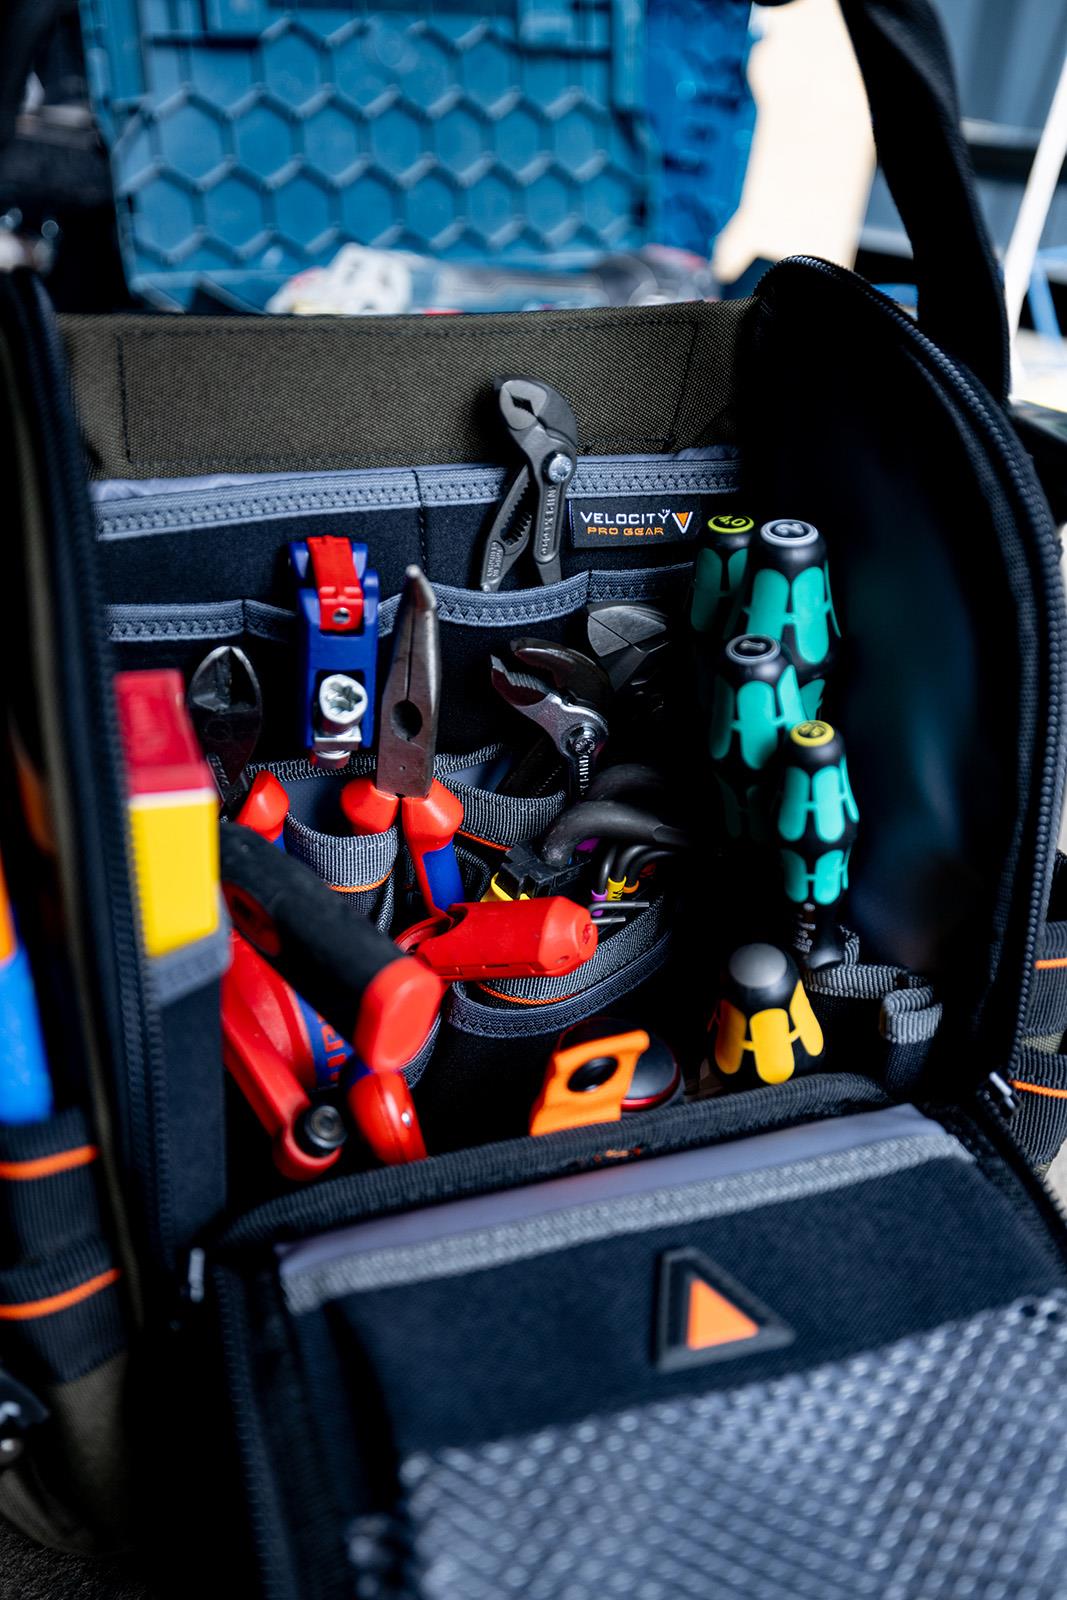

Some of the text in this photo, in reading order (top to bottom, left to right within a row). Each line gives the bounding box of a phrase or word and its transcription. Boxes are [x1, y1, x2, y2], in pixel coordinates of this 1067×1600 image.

[580, 511, 669, 524] VELOCITY
[587, 527, 664, 536] PRO GEAR
